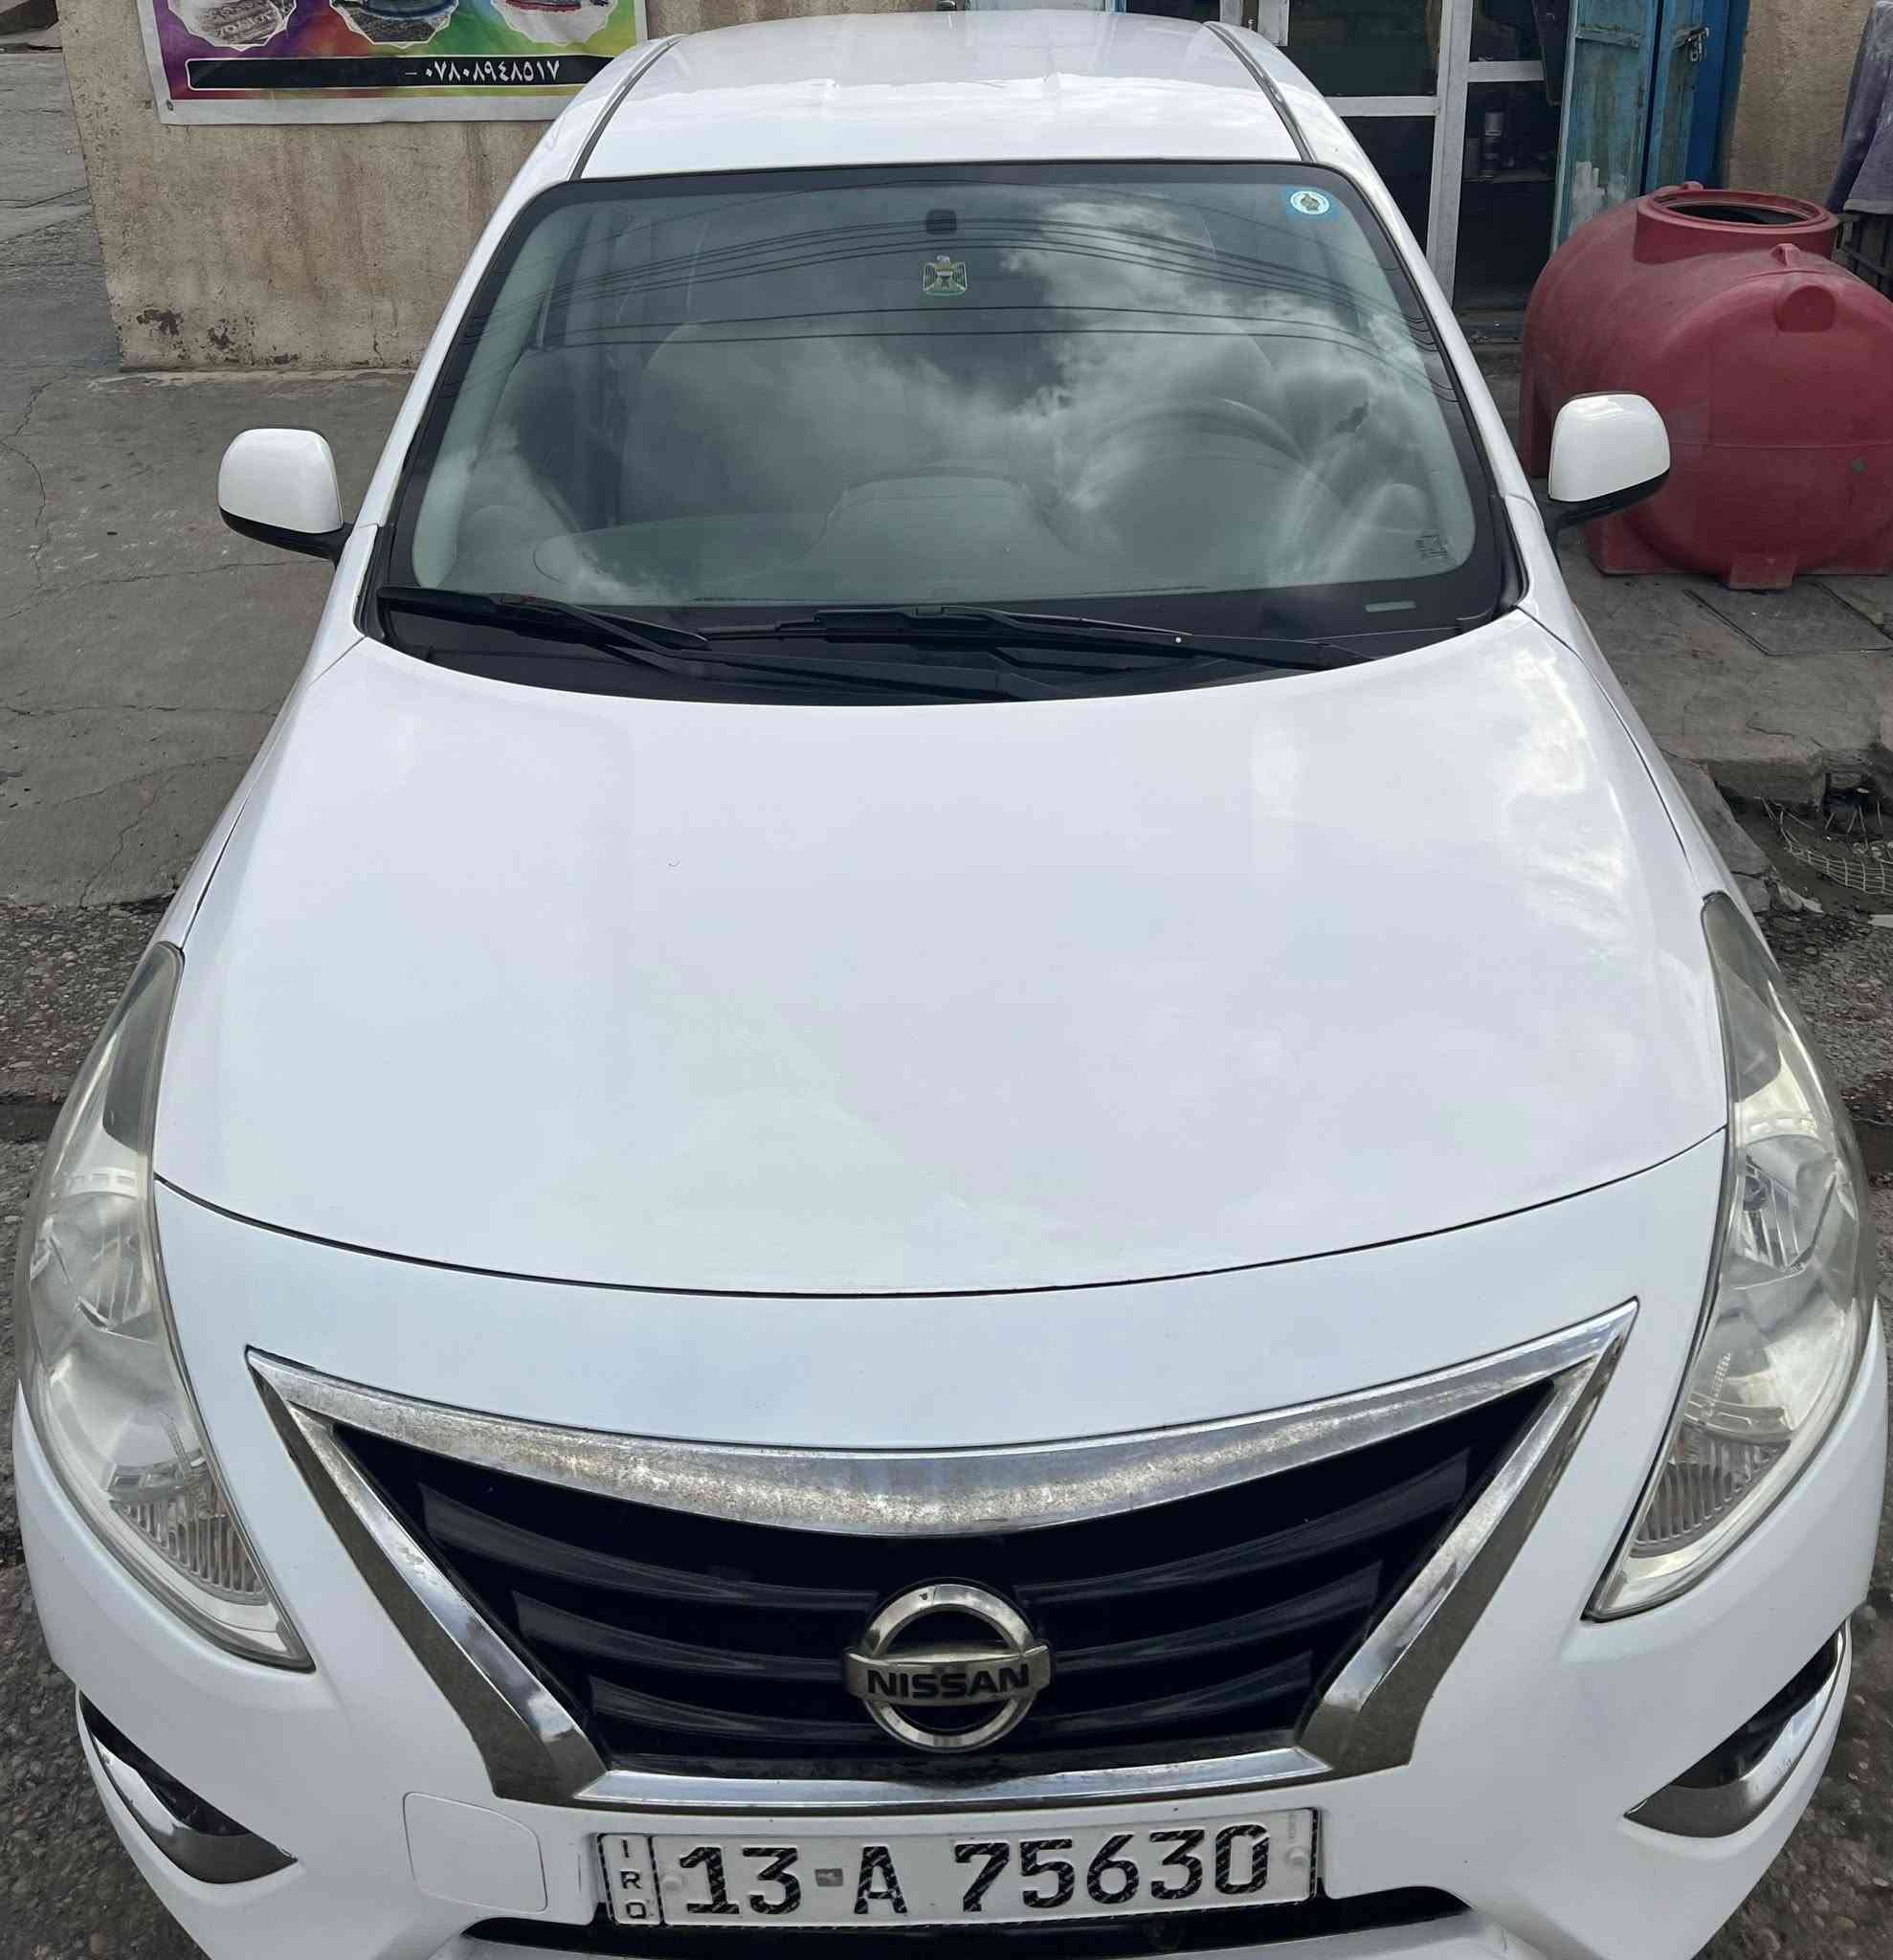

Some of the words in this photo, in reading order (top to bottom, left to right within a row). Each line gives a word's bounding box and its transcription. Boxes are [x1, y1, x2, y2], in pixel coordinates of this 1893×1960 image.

[425, 59, 561, 82] ٠٧٨٠٨٩٤٨٥١٧
[867, 1662, 1030, 1700] NISSAN
[679, 1845, 802, 1915] 13
[853, 1846, 908, 1915] A
[953, 1823, 1270, 1913] 75630
